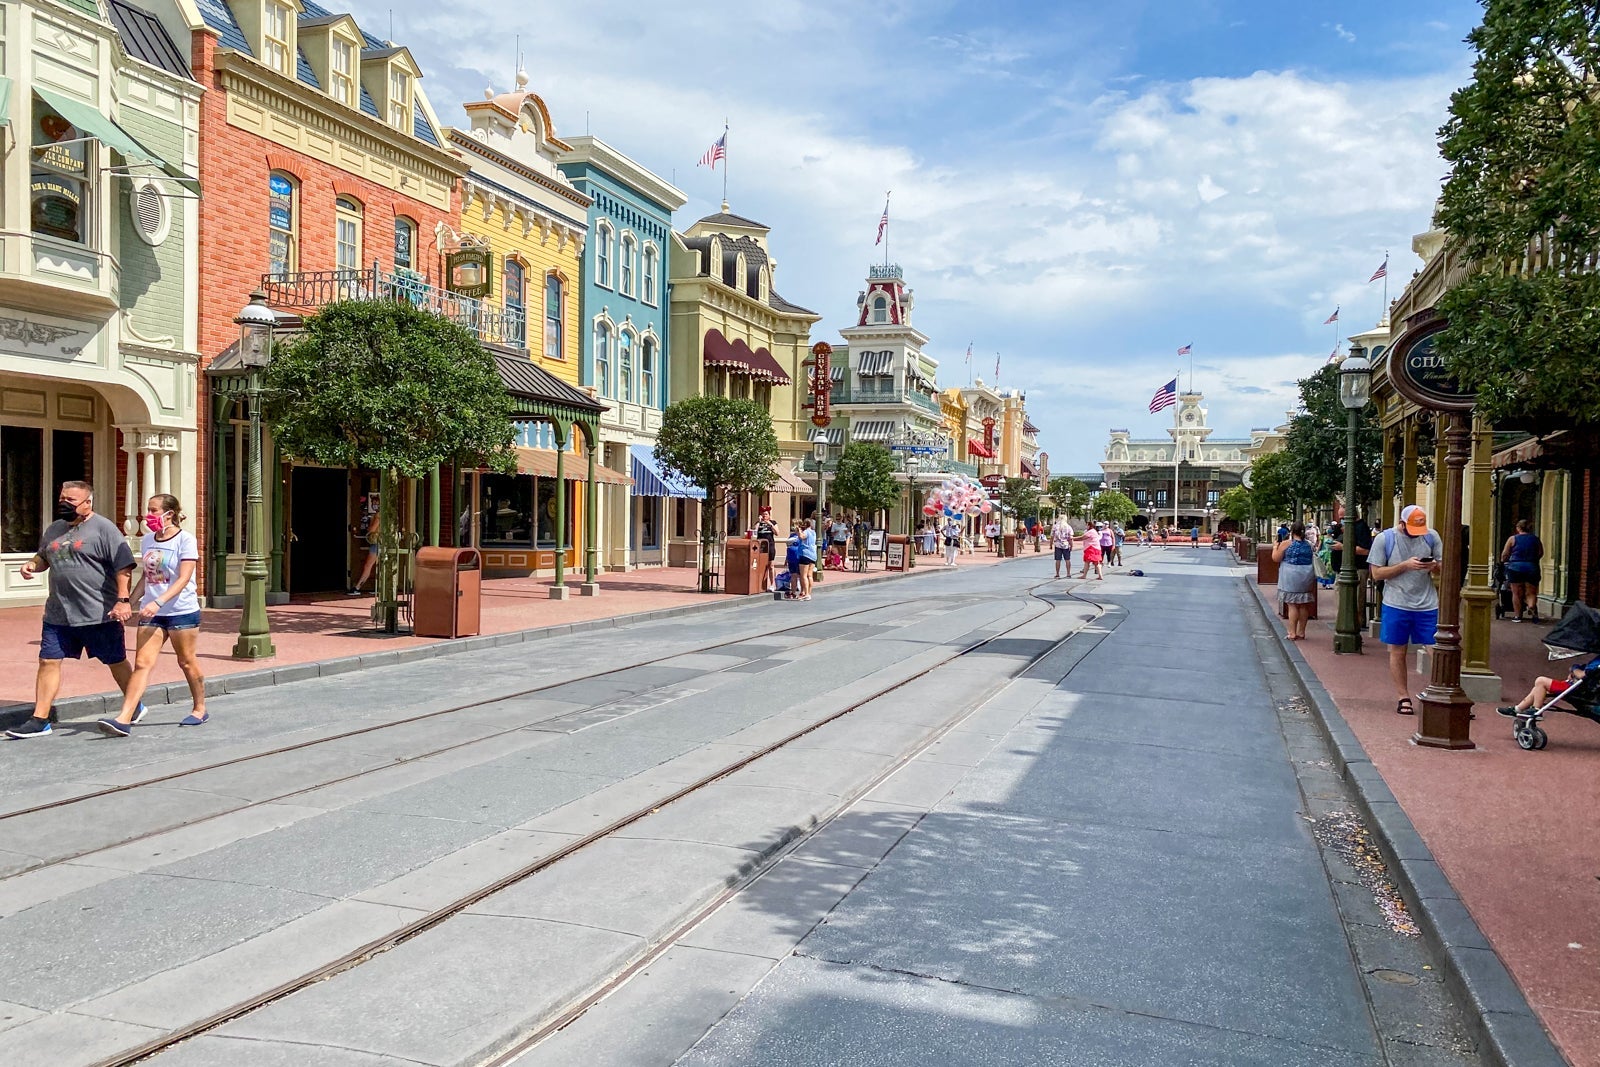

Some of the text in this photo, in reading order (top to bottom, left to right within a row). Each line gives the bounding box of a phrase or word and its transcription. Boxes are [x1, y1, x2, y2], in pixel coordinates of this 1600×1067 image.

[57, 154, 85, 170] COMPANY
[454, 287, 482, 298] COFFEE
[817, 353, 825, 416] CRYSTAL ARTS
